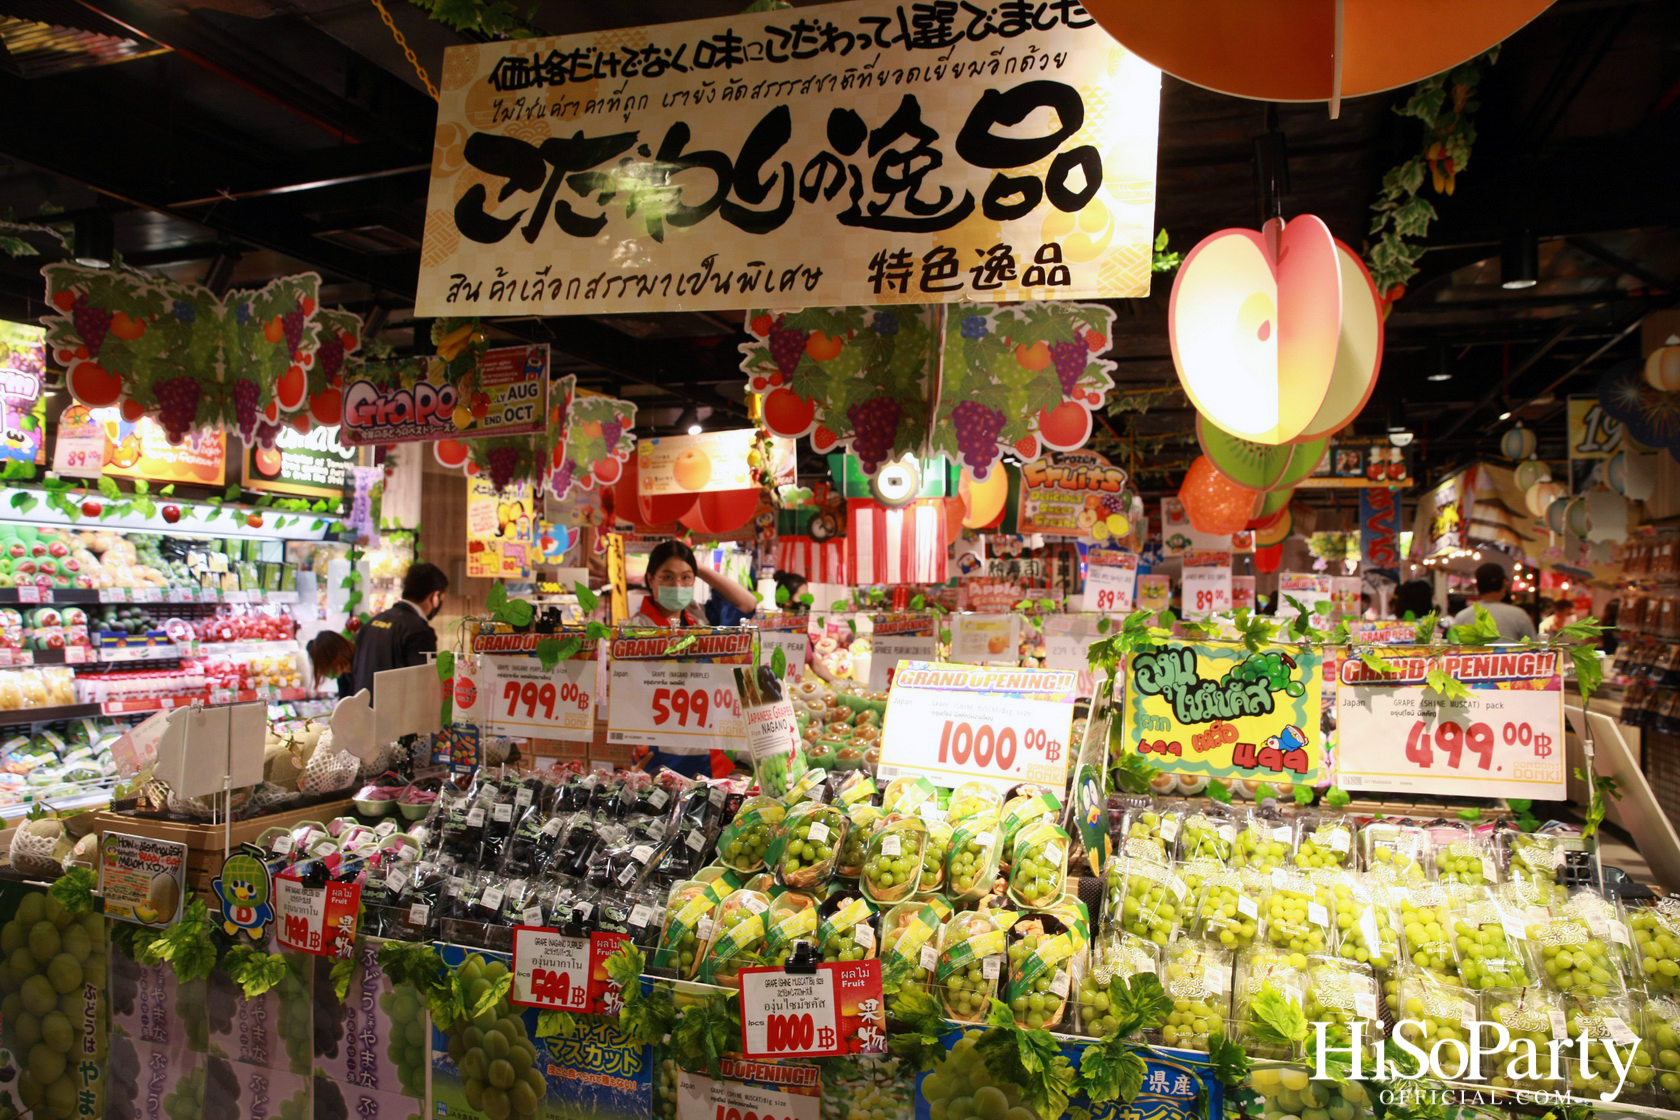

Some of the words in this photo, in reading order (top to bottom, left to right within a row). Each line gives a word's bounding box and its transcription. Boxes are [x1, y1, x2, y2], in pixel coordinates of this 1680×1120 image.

[868, 243, 1072, 291] 特色逸品
[508, 383, 538, 401] AUG
[485, 415, 501, 425] END
[504, 405, 533, 422] OCT
[1023, 459, 1124, 493] Fruits
[968, 581, 1022, 597] Apple
[474, 635, 519, 652] GRAND
[613, 638, 664, 658] GRAND
[900, 671, 969, 687] GRAND
[969, 672, 1072, 692] OPENING!!
[1342, 698, 1366, 707] Japan
[1393, 699, 1415, 707] GRAPE
[1420, 699, 1446, 708] (SHINE
[1450, 700, 1480, 709] MUSCAT)
[1486, 702, 1505, 710] pack
[761, 719, 788, 735] NAGANO
[1137, 738, 1183, 757] 699
[1232, 742, 1309, 775] 499
[331, 897, 348, 905] Fruit
[336, 914, 355, 958] 果物
[841, 964, 870, 979] ผลไม้
[841, 980, 865, 988] Fruit
[857, 998, 886, 1051] 果物
[547, 1034, 644, 1078] マスカット
[735, 1062, 818, 1086] OPENING!!
[1143, 1070, 1194, 1097] 県産
